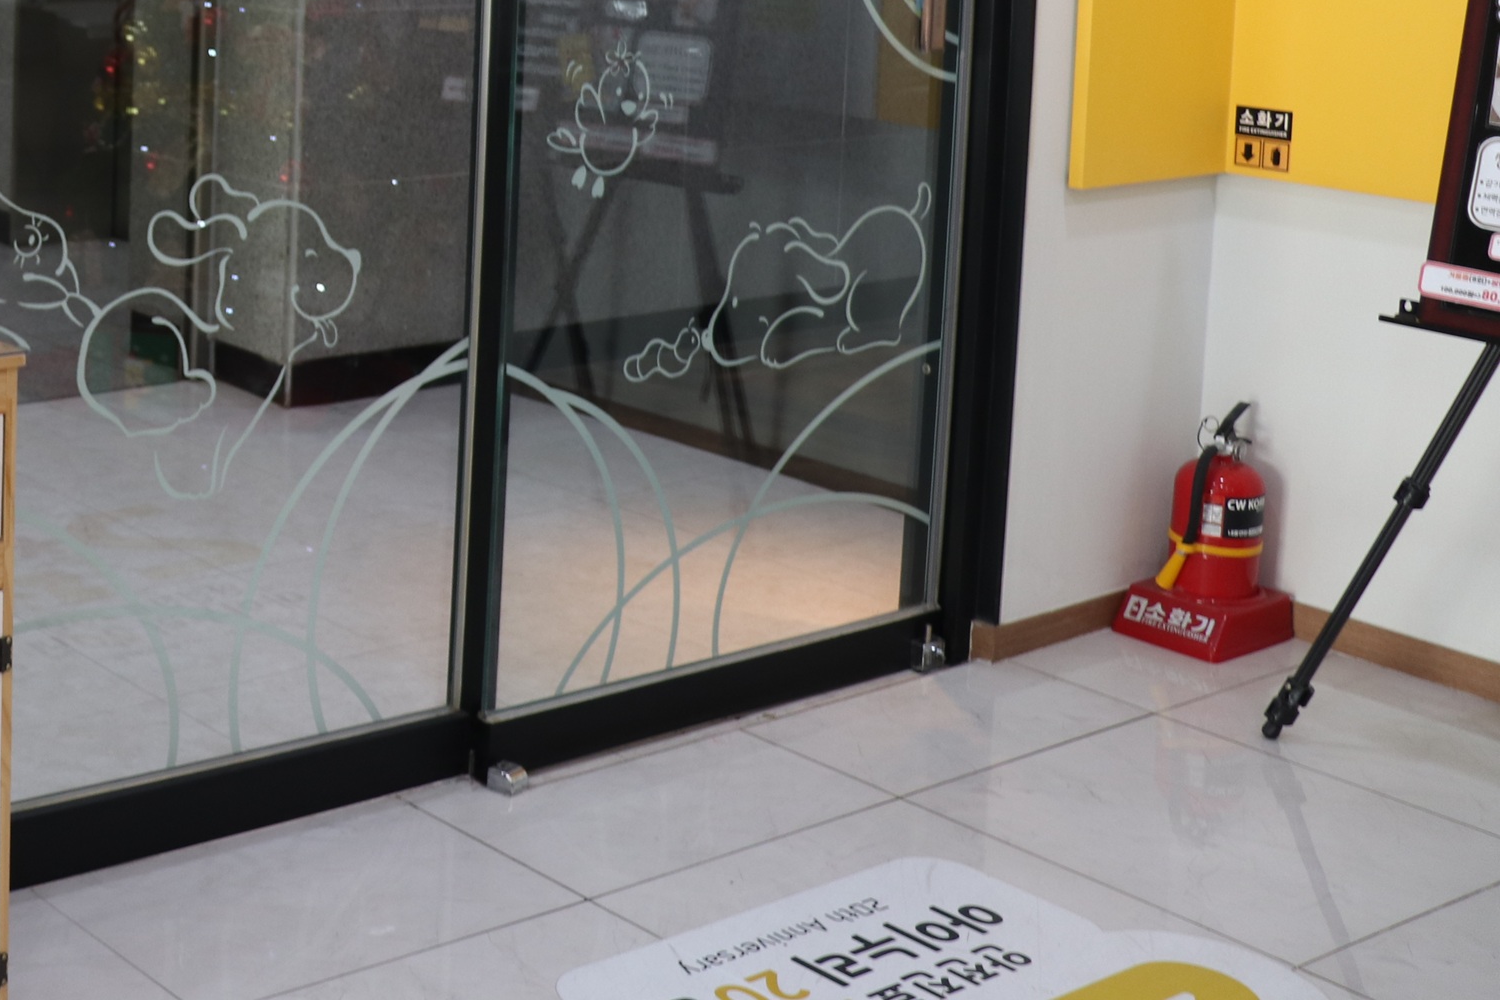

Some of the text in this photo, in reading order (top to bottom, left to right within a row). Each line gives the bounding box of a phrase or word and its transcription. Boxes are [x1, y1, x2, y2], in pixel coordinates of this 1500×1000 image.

[1239, 108, 1289, 131] 소화기
[1227, 498, 1247, 511] CW
[1145, 601, 1216, 637] 소화기
[678, 897, 889, 977] 20th Anniversary
[791, 904, 1004, 987] 아이누리
